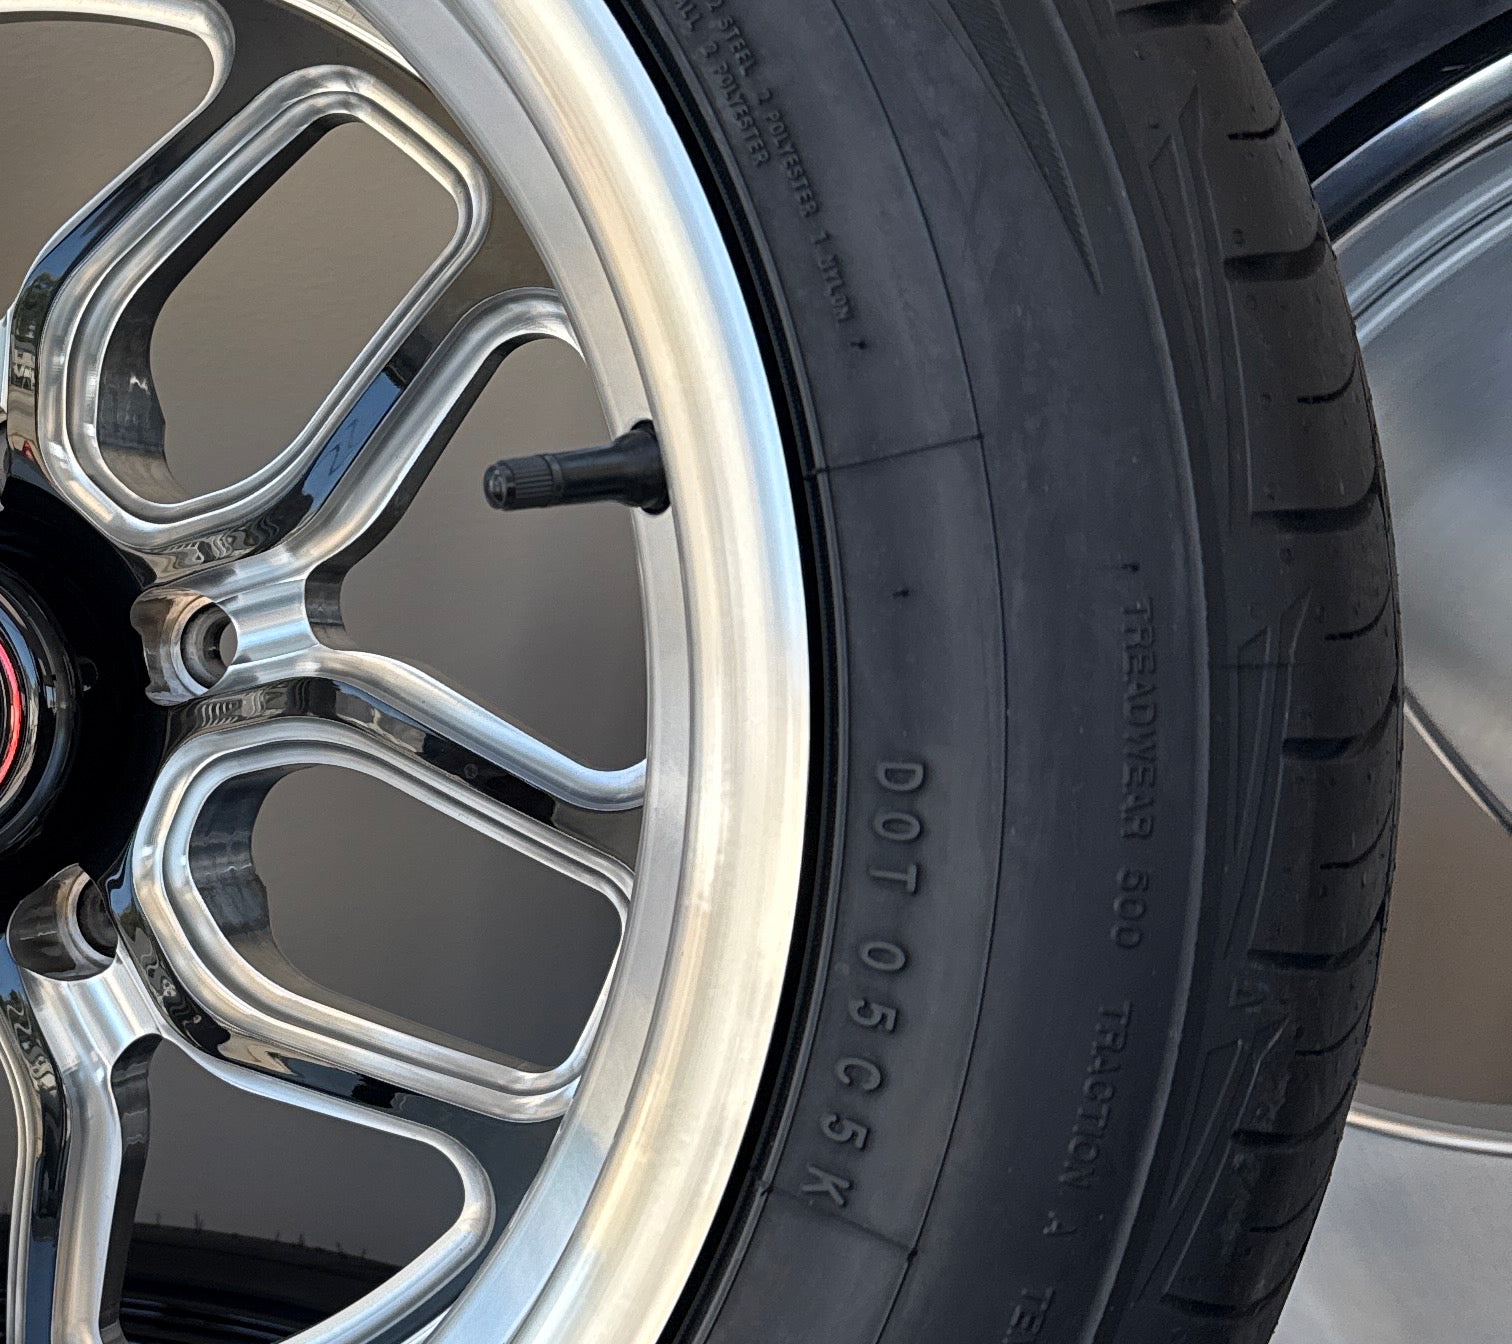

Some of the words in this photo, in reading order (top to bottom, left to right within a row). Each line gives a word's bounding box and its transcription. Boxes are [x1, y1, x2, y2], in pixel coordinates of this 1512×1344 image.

[710, 59, 770, 169] POLYESTER
[715, 12, 759, 80] STEEL
[762, 104, 823, 221] POLYESTER
[1117, 596, 1159, 842] TREADWEAR
[872, 759, 925, 892] DOT
[1059, 997, 1135, 1194] TRACTION
[1040, 1208, 1081, 1247] A
